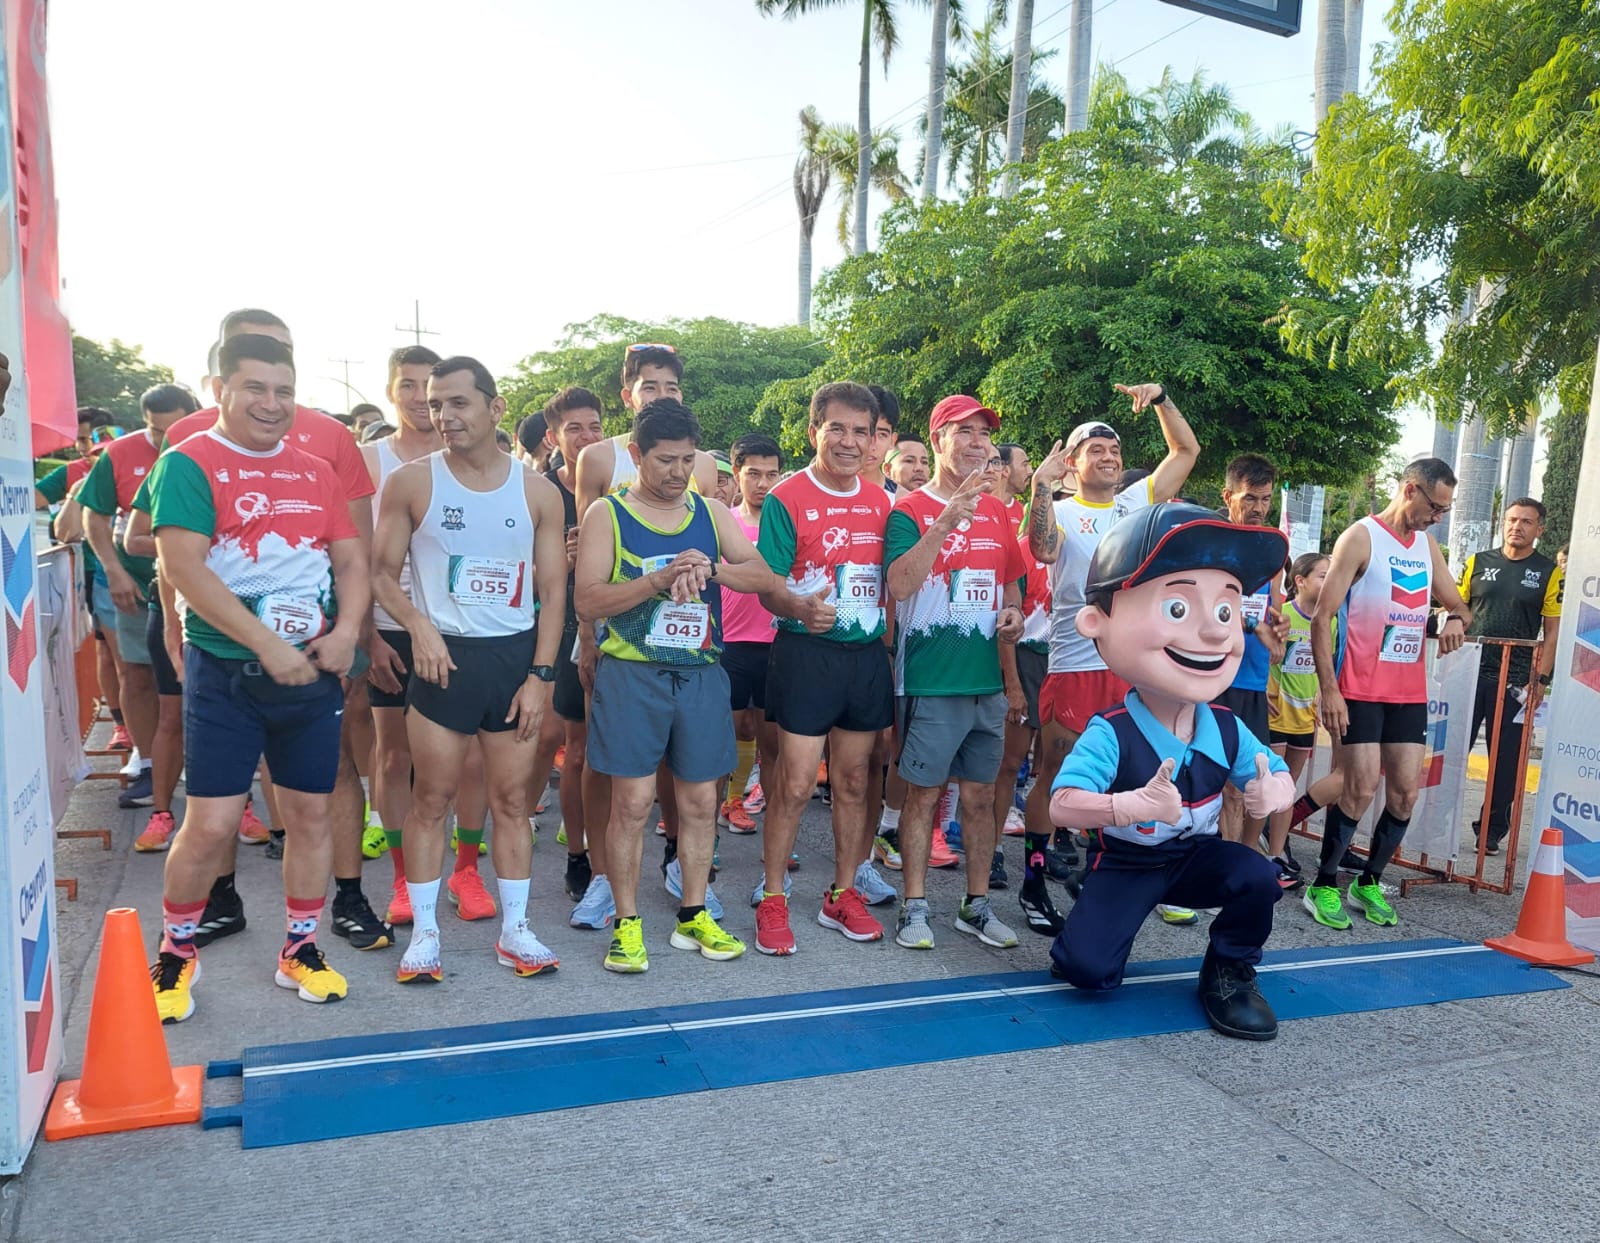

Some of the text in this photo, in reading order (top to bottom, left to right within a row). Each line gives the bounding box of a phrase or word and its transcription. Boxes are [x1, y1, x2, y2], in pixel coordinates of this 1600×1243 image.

[1388, 556, 1427, 569] Chevron
[470, 579, 508, 595] 055
[852, 585, 876, 597] 016
[965, 589, 989, 601] 110
[1388, 612, 1426, 623] NAVOJO
[273, 617, 309, 635] 162
[665, 623, 701, 637] 043
[1393, 642, 1419, 654] 008
[1578, 765, 1600, 781] OFI
[19, 857, 48, 927] Chevron
